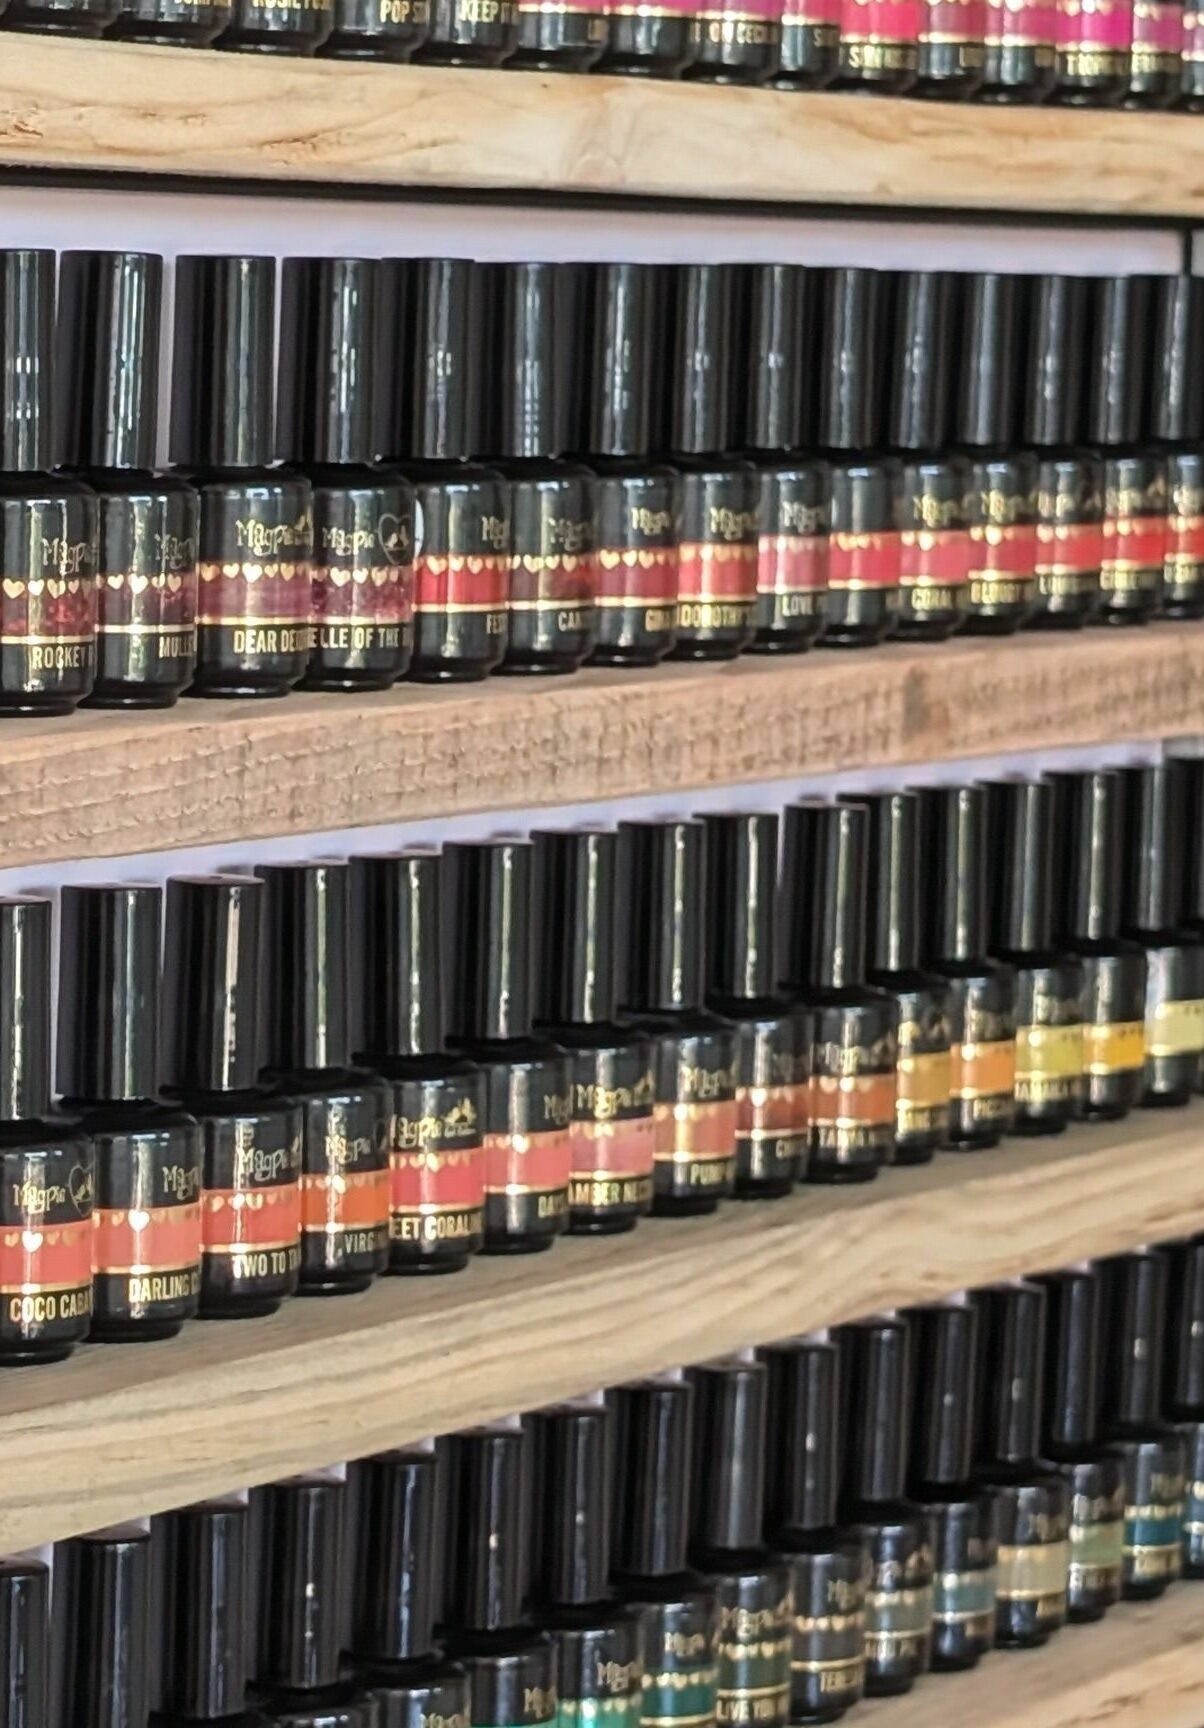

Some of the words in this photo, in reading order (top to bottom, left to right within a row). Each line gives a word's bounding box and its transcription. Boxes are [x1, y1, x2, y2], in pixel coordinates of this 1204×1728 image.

[234, 629, 277, 655] DEAR
[13, 1180, 66, 1215] Magpie
[231, 1253, 268, 1279] TWO
[271, 1252, 286, 1274] TO
[128, 1275, 190, 1303] DARLING
[9, 1296, 56, 1323] COCO
